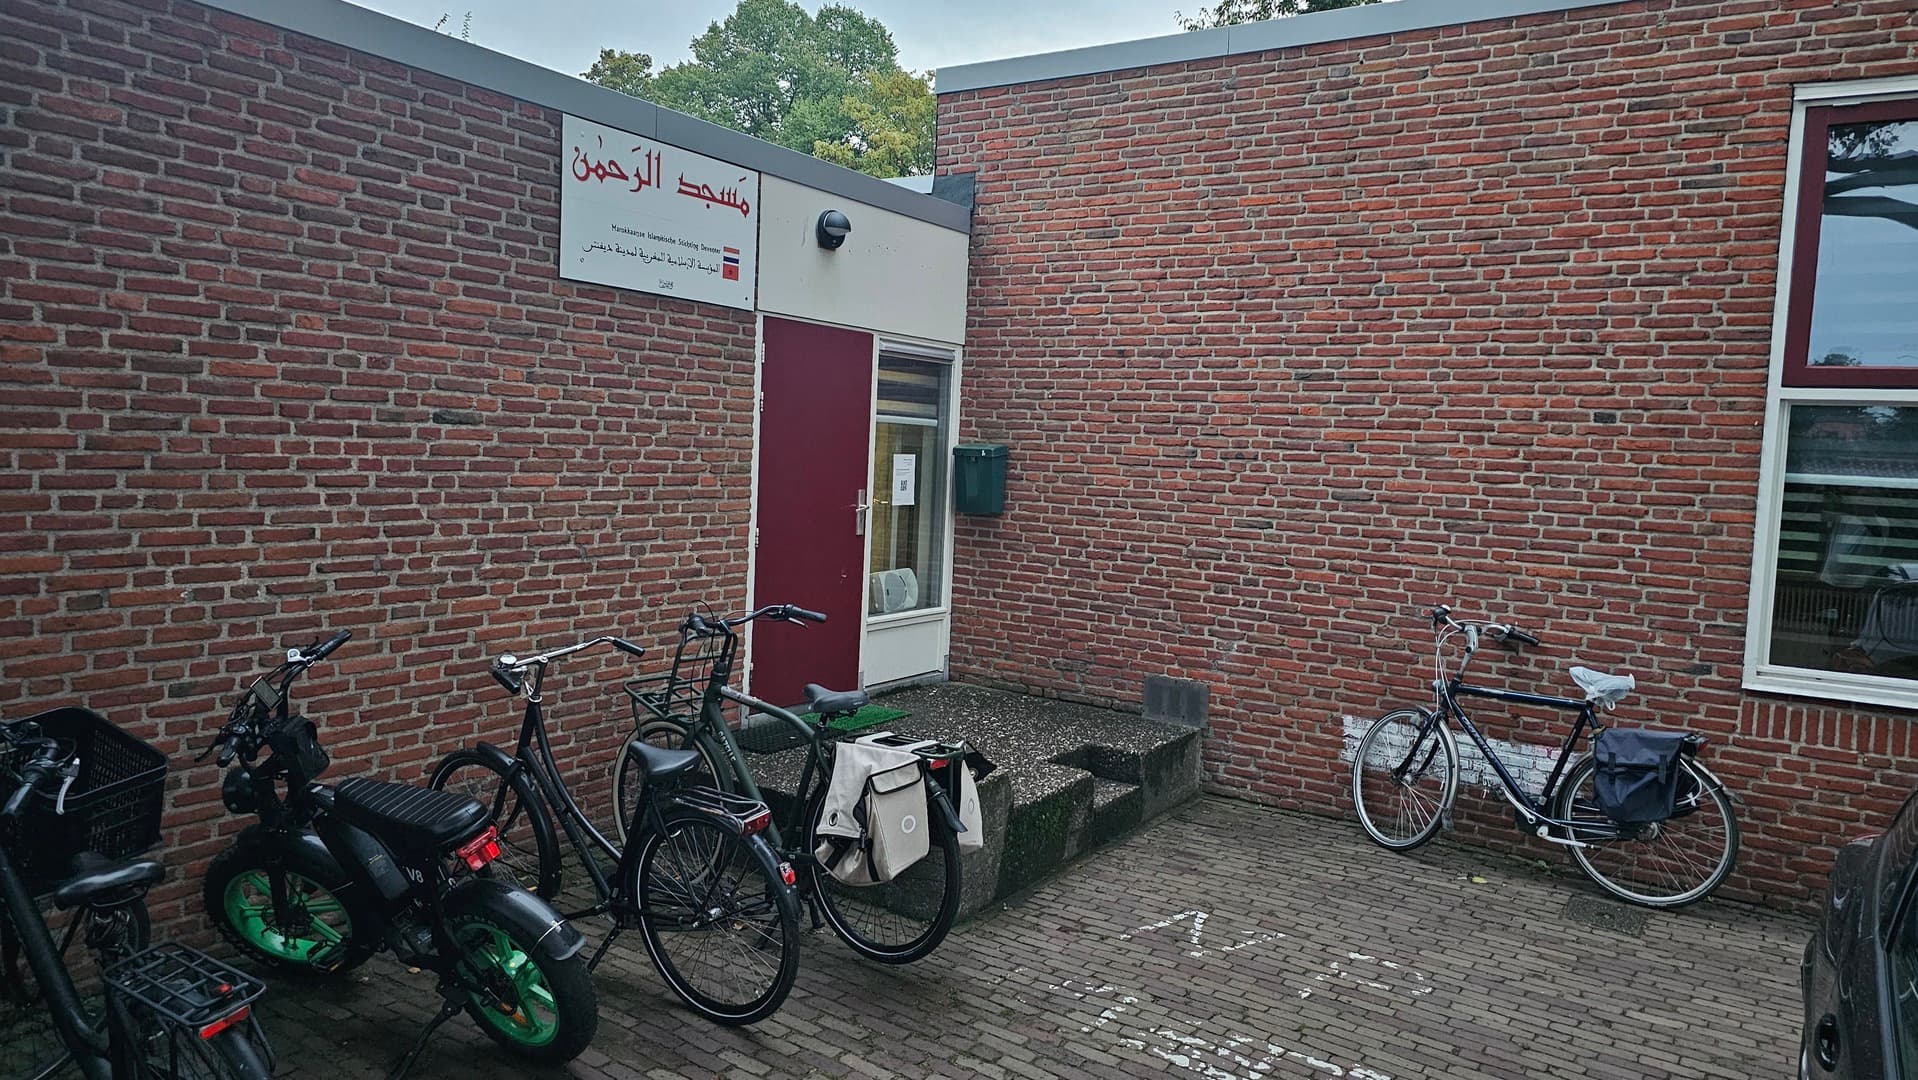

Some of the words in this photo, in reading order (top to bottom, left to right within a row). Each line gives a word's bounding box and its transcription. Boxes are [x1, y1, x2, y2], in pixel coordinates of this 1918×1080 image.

[611, 223, 645, 239] Marokkaanse
[647, 231, 676, 245] Islamitische
[678, 237, 700, 252] Stichting
[700, 243, 721, 255] Deventer
[405, 866, 424, 884] V8
